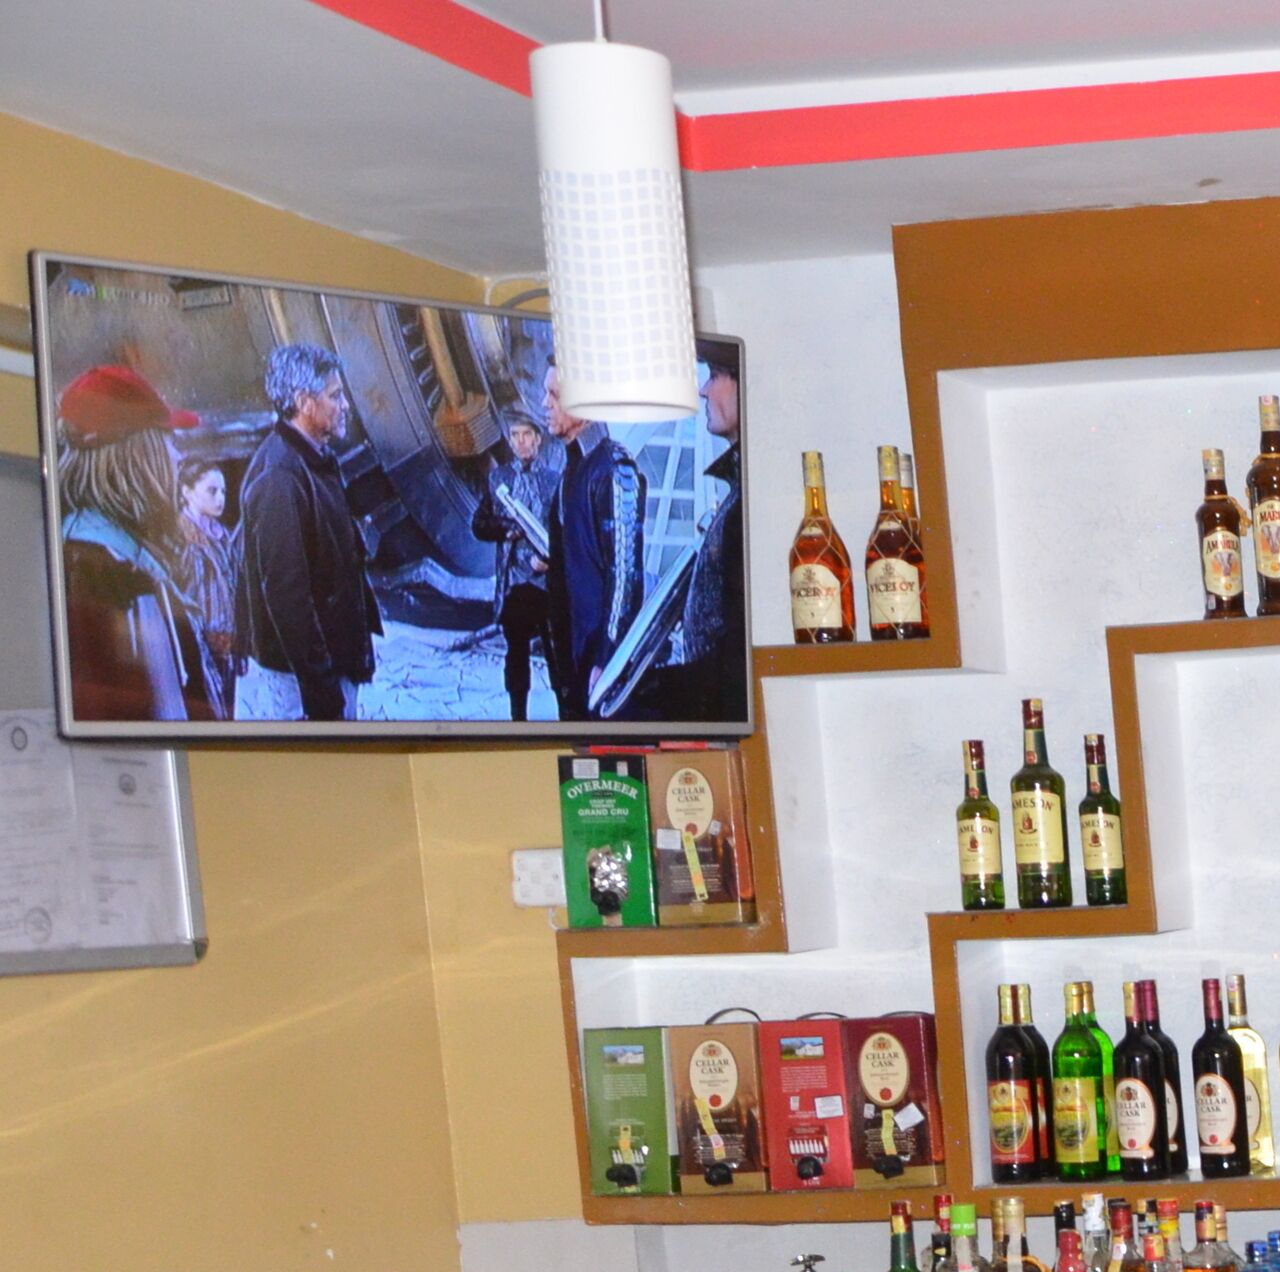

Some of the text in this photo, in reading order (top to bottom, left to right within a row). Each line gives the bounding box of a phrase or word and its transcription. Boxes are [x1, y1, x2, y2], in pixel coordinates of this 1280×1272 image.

[567, 779, 638, 800] OVERMEER
[865, 1052, 900, 1062] CELLAR
[695, 1058, 731, 1068] CELLAR
